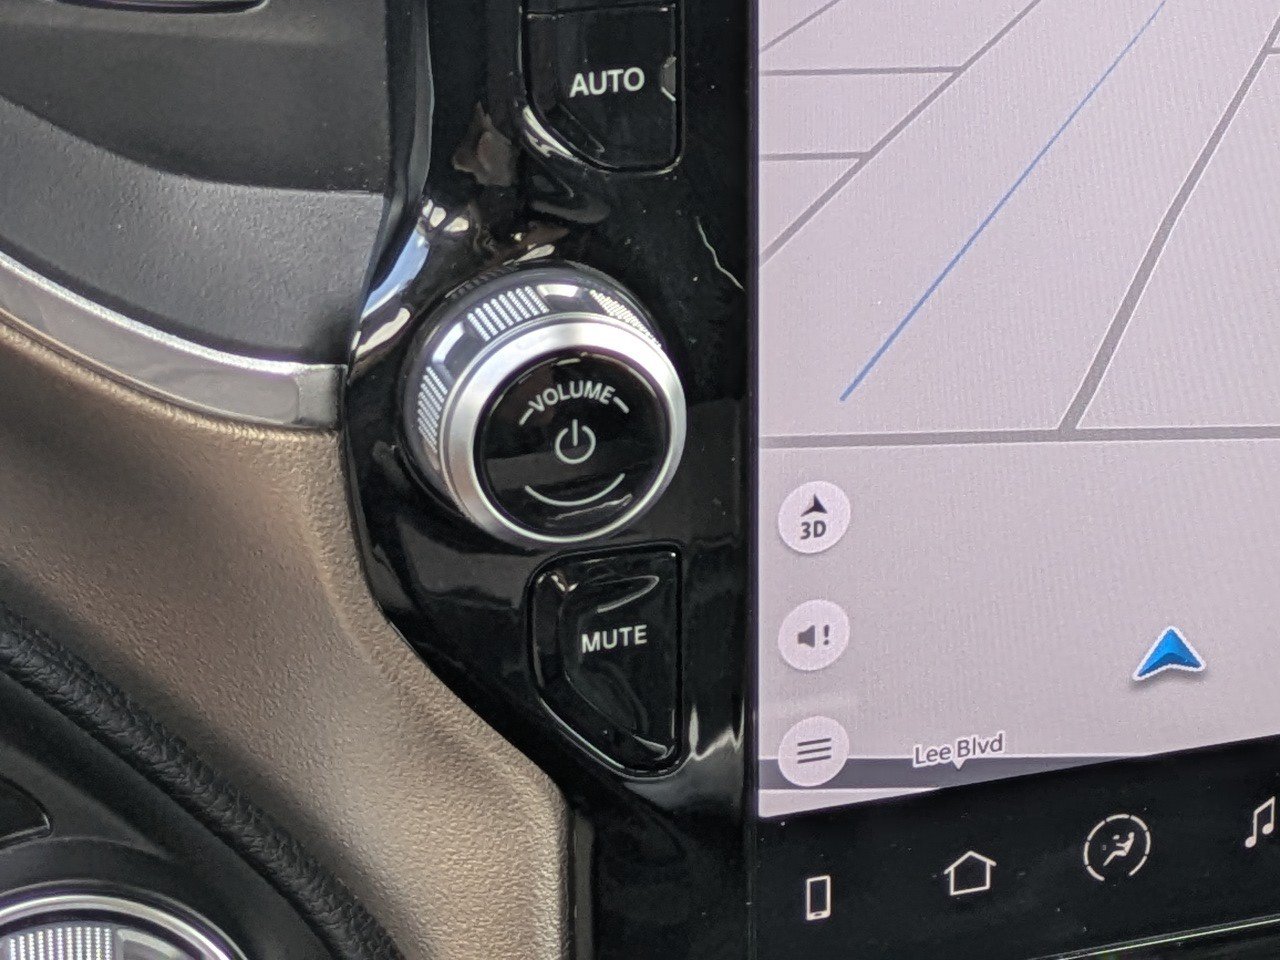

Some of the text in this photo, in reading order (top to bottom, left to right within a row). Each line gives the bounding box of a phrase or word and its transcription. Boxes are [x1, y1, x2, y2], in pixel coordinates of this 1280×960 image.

[569, 66, 646, 99] AUTO
[528, 380, 616, 414] VOLUME
[799, 520, 827, 540] 3D
[581, 625, 648, 654] MUTE
[913, 733, 1004, 767] Lee Blvd
